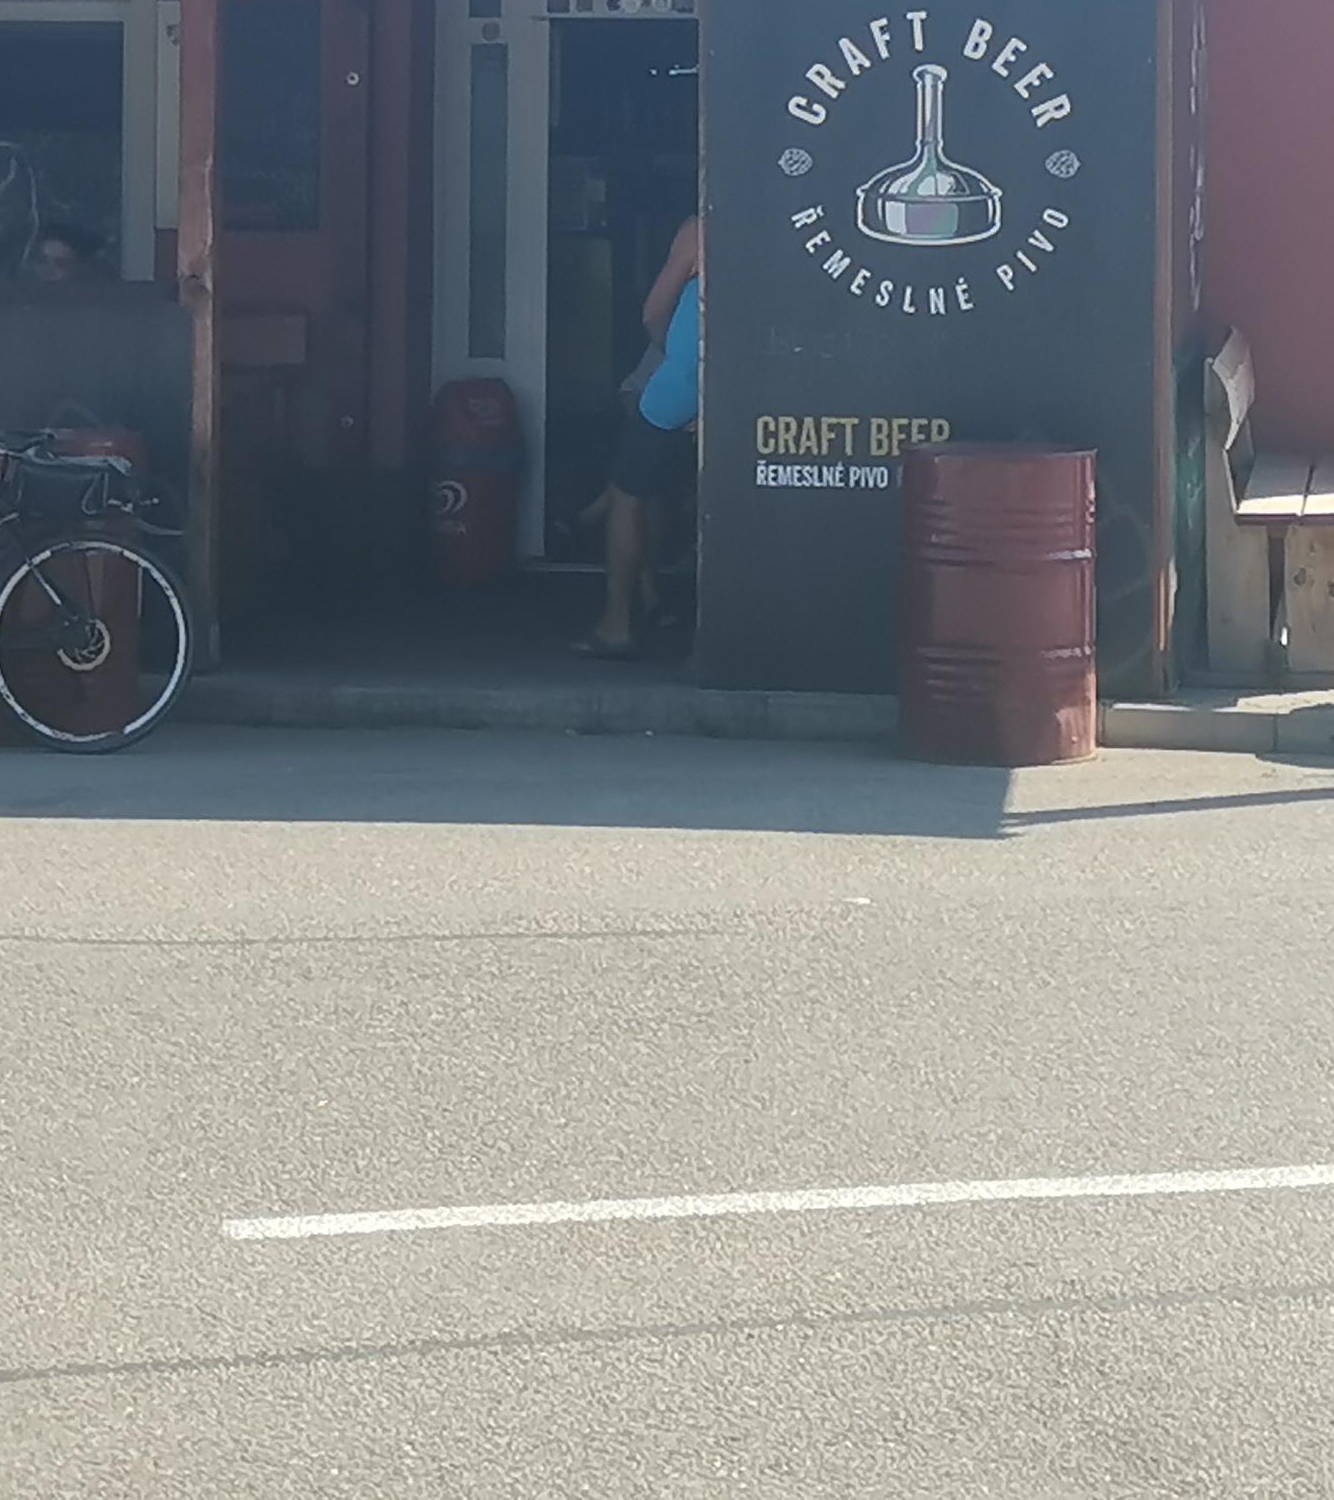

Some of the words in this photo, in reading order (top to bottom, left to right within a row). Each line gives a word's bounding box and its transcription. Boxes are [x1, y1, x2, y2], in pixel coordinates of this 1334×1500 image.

[788, 11, 927, 125] CRAFT
[963, 19, 1071, 128] BEER
[791, 205, 974, 315] ŘEMESLNÉ
[996, 208, 1069, 291] PIVO
[757, 416, 859, 456] CRAFT
[756, 460, 846, 487] ŘEMESLNÉ
[850, 466, 888, 488] PIVO
